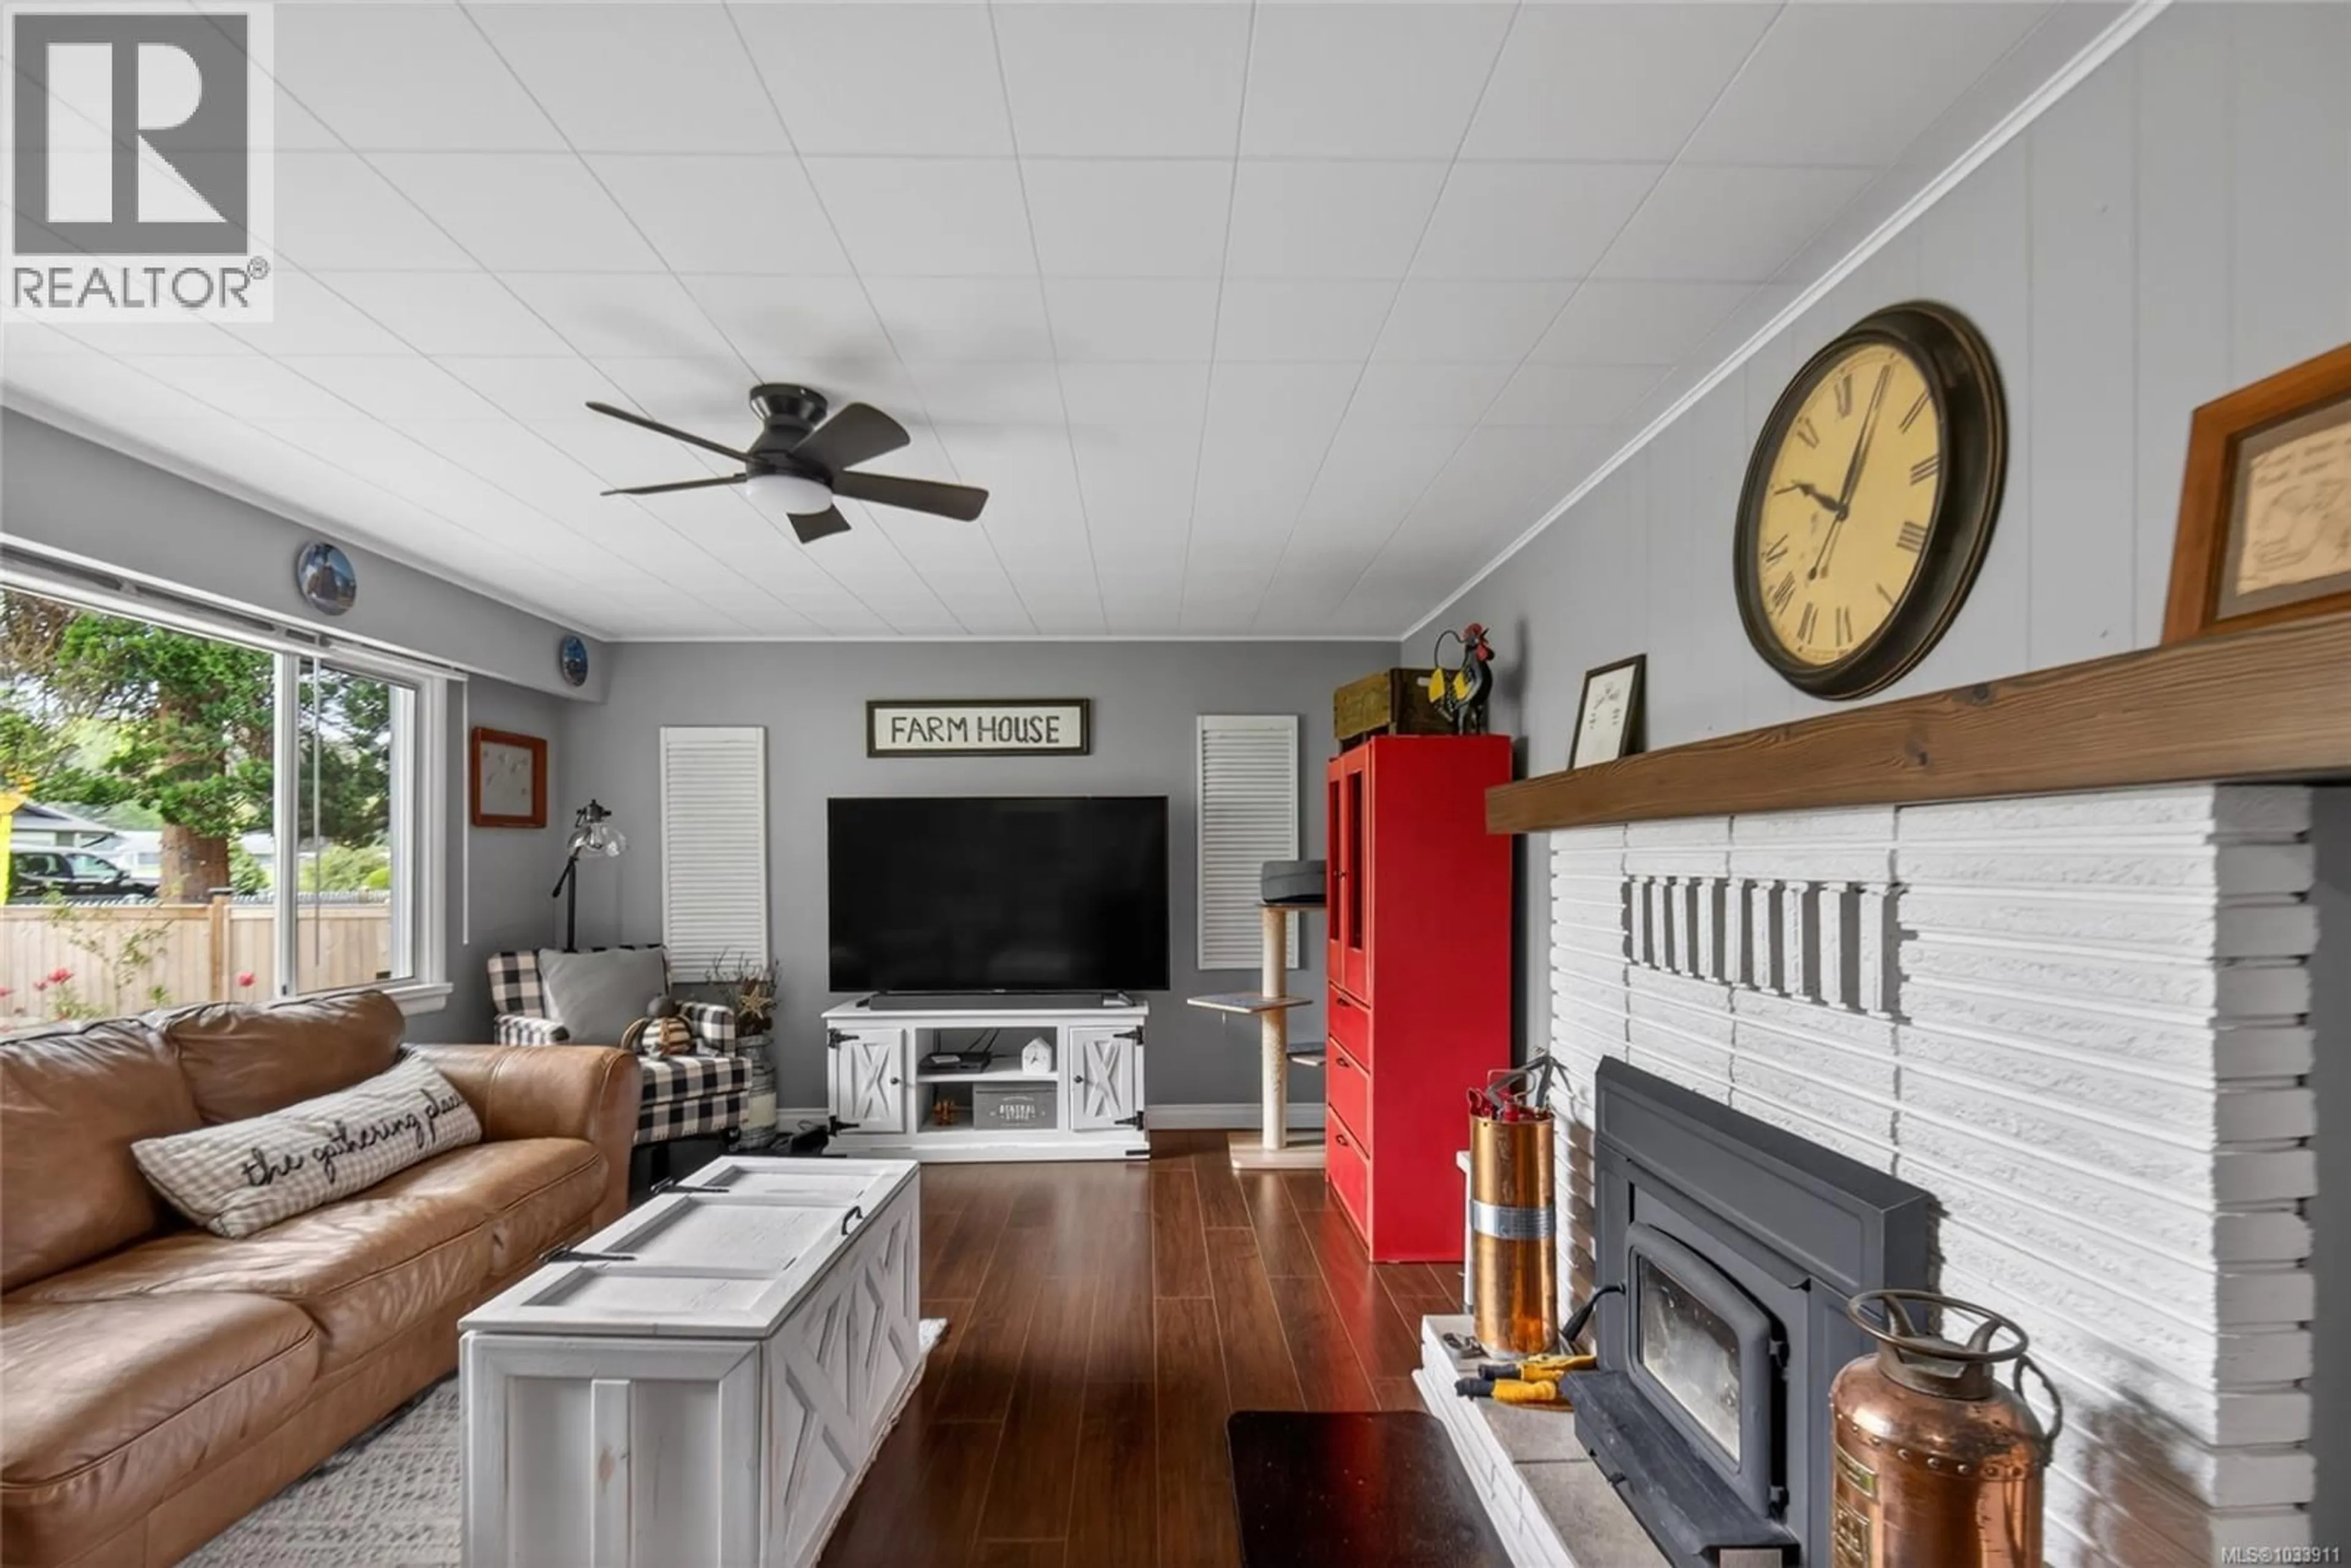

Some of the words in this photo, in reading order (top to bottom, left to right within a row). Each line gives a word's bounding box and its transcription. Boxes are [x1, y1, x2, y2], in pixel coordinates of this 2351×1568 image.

[891, 716, 968, 743] FARM
[978, 715, 1060, 743] HOUSE
[242, 1147, 305, 1187] the
[312, 1112, 425, 1185] gathering
